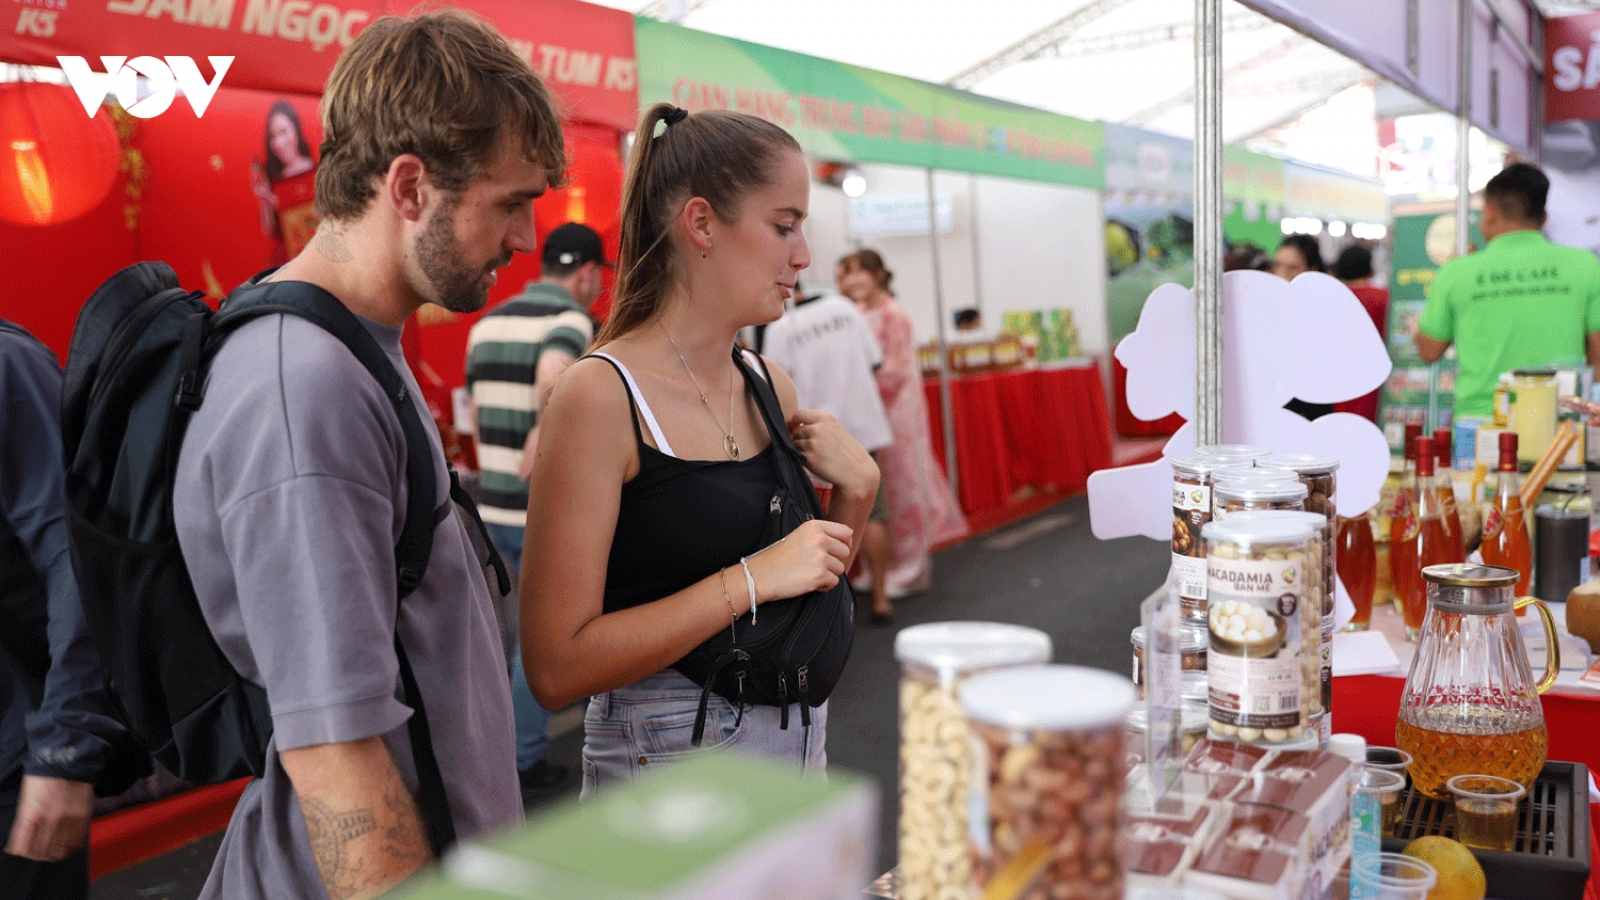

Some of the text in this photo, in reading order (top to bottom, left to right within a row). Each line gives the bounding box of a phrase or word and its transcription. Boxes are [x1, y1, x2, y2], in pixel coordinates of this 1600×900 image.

[15, 7, 58, 38] K5
[242, 0, 368, 51] NGỌC
[540, 42, 602, 87] TUM
